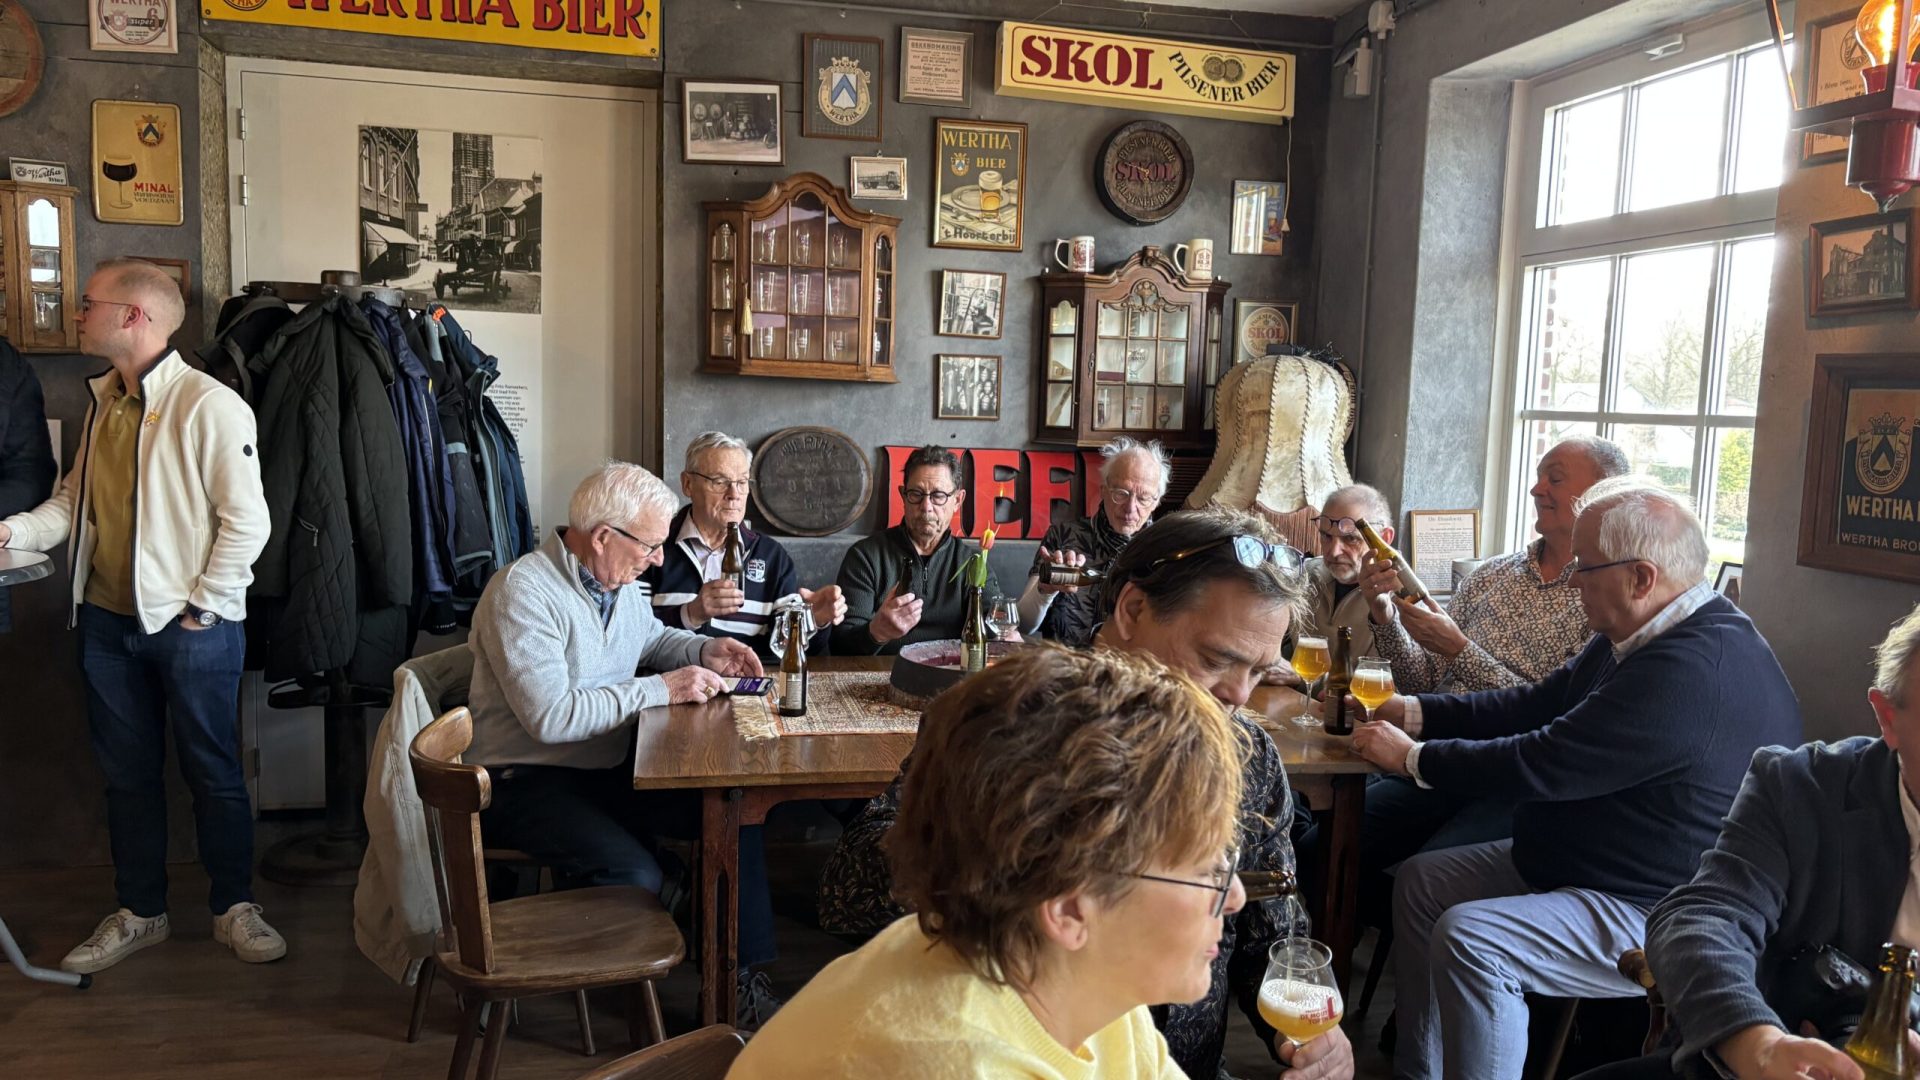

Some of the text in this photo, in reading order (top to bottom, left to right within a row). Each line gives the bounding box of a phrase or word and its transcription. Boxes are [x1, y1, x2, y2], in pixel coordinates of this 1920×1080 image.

[287, 0, 645, 39] THA BIER
[1020, 35, 1280, 102] SKOL PILSENER BIER
[830, 109, 860, 122] WERTHA
[942, 130, 1012, 150] WERTHA
[976, 157, 1007, 169] BIER
[1115, 161, 1177, 183] SKOL
[134, 182, 174, 193] MINAL
[1248, 327, 1283, 340] SKOL
[1846, 495, 1914, 521] WERTHA
[1841, 532, 1920, 552] WERTHA BRO
